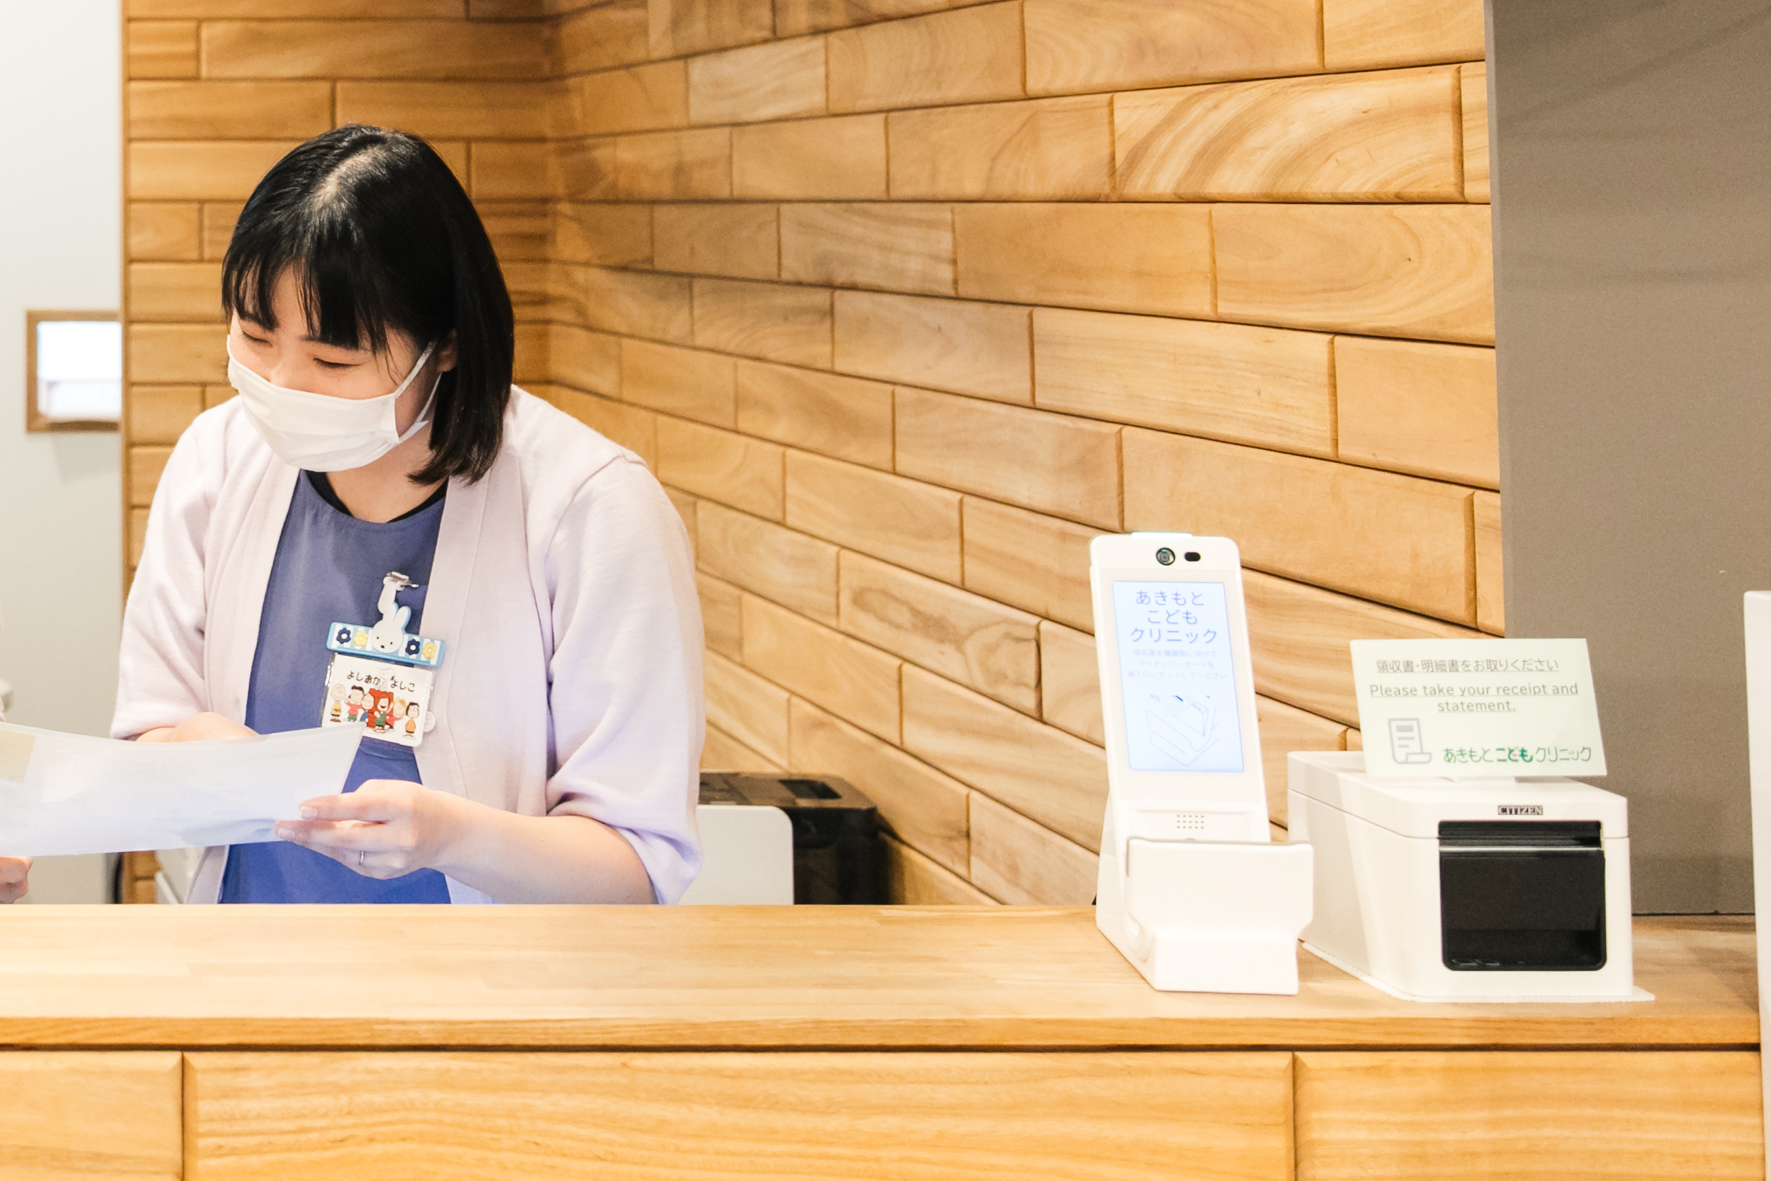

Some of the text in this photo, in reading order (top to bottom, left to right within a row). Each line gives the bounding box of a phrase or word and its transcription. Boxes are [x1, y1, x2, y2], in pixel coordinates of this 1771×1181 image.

[1135, 590, 1205, 606] あきもと
[1147, 609, 1198, 625] こども
[1130, 627, 1217, 644] クリニック
[347, 671, 381, 685] よしおか
[1369, 682, 1579, 698] Please take your receipt and
[1437, 700, 1517, 713] statement.
[1498, 806, 1542, 815] CITIZEN
